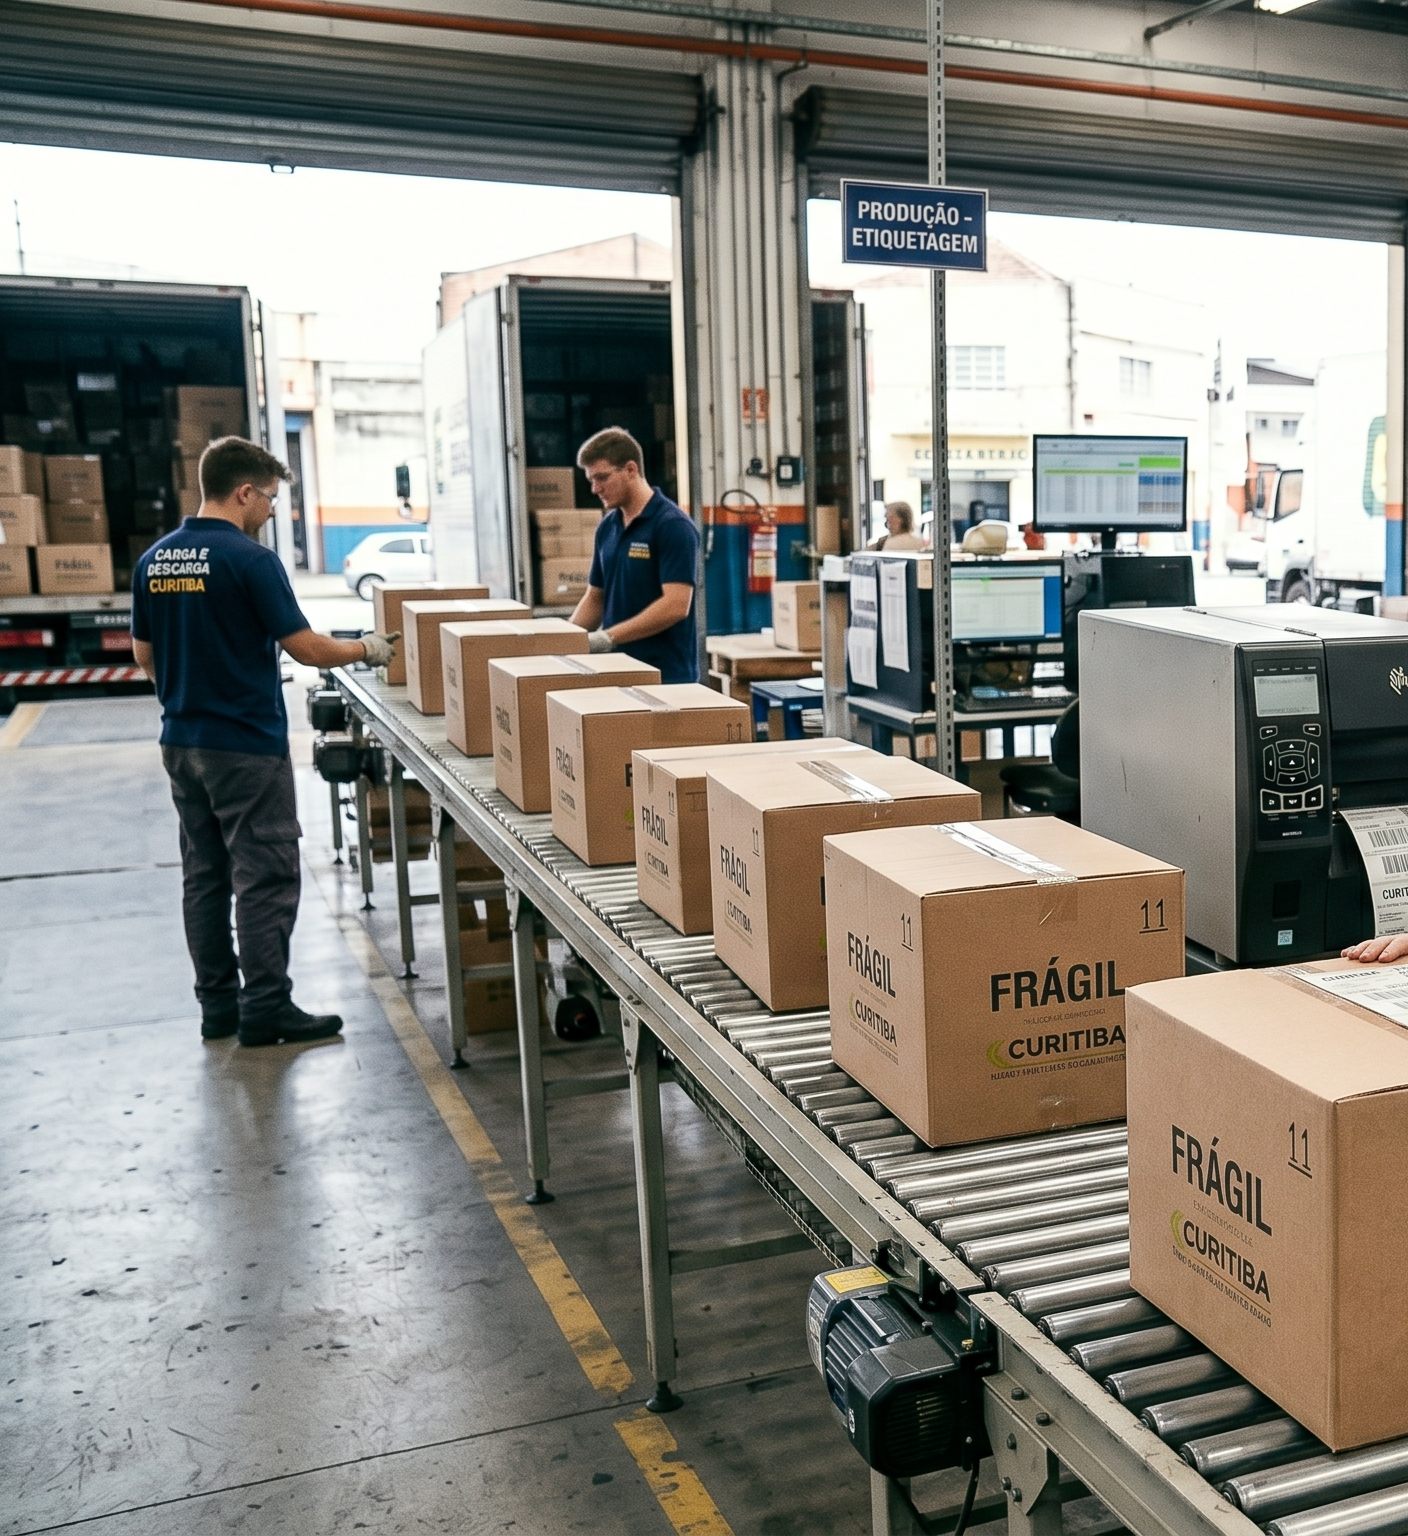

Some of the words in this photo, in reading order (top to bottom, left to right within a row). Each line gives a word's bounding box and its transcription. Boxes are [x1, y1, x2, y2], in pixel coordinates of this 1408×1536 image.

[858, 201, 960, 229] PRODUÇÃO
[852, 227, 978, 254] ETIQUETAGEM
[147, 562, 210, 577] DESCARGA
[155, 548, 197, 561] CARGA
[199, 547, 210, 560] E
[149, 578, 206, 593] CURITIBA
[720, 844, 751, 897] FRÁGIL
[847, 931, 896, 999] FRÁGIL
[990, 956, 1126, 1013] FRÁGIL
[855, 999, 898, 1048] CURITIBA
[1008, 1025, 1126, 1060] CURITIBA
[1171, 1124, 1273, 1237] FRÁGIL
[1183, 1220, 1271, 1303] CURITIBA
